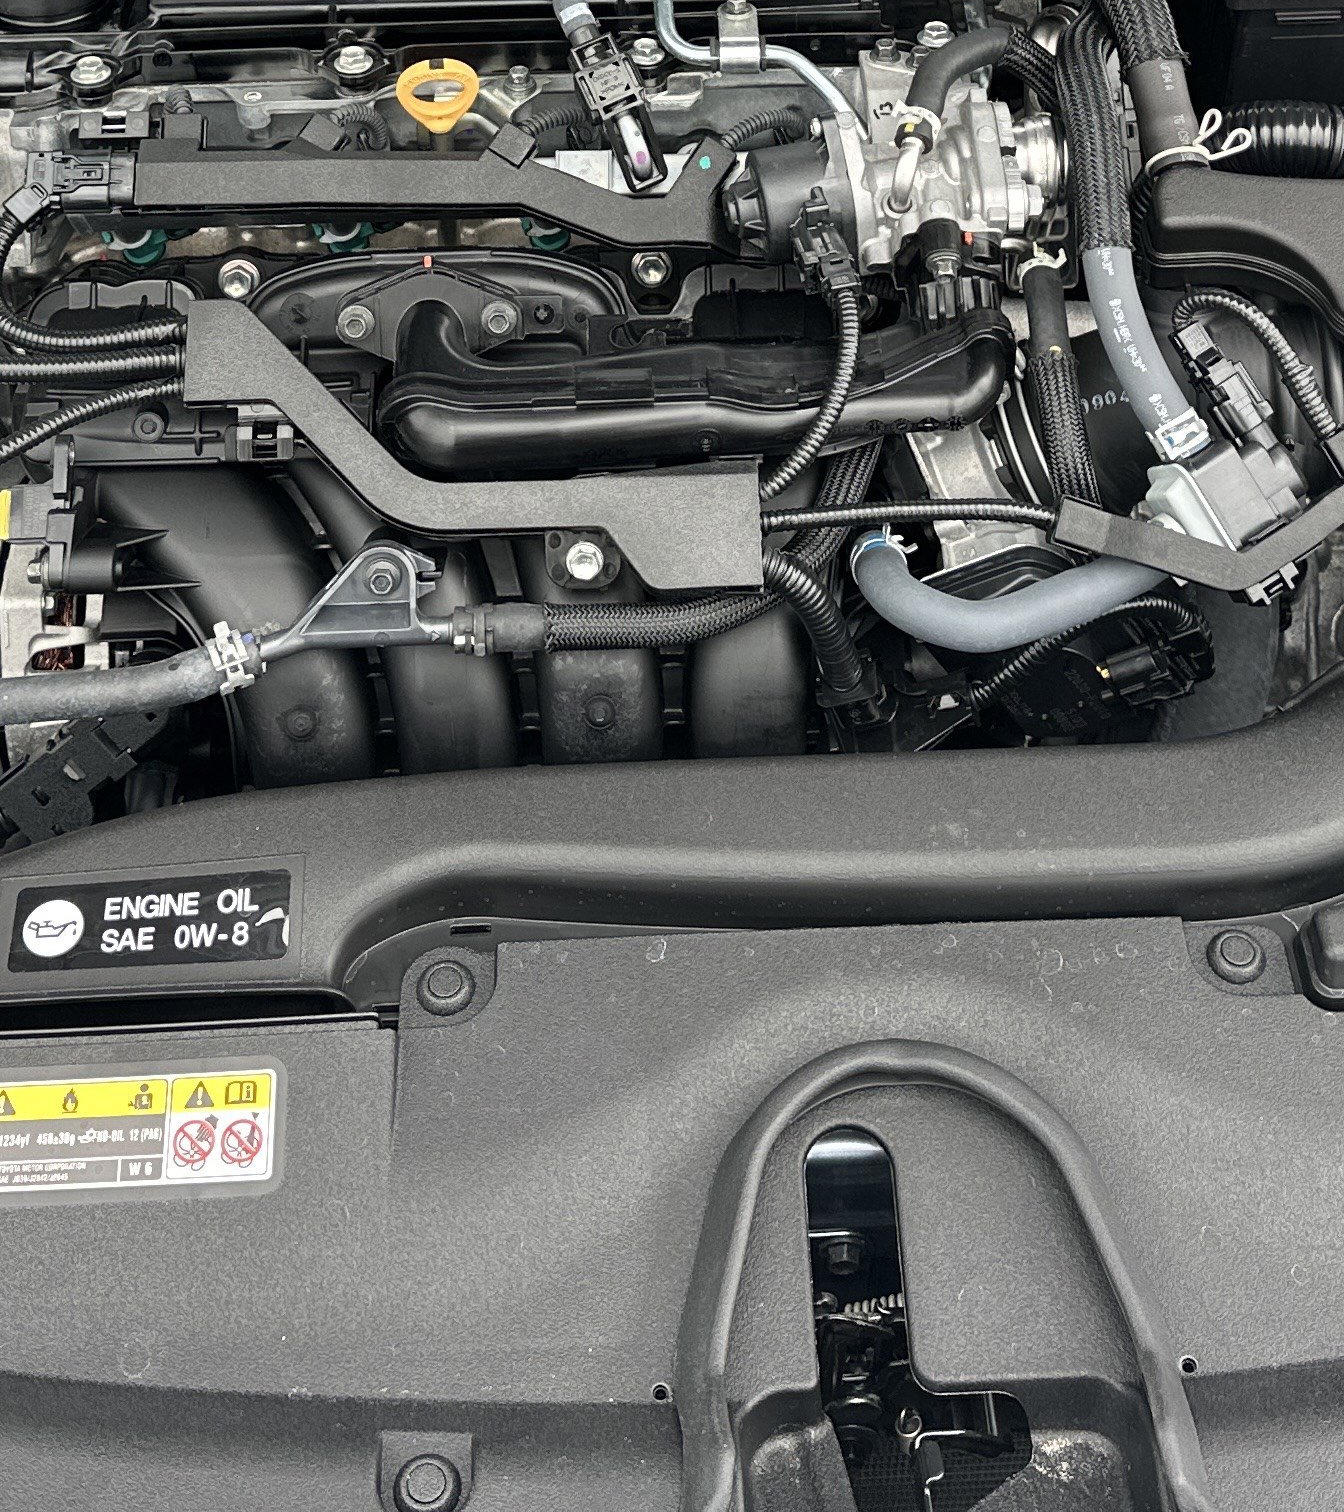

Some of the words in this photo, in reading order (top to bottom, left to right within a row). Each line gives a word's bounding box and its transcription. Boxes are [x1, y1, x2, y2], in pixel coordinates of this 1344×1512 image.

[104, 891, 200, 921] ENGINE
[216, 888, 259, 914] OIL
[100, 926, 156, 953] SAE
[174, 921, 249, 950] 0W-8
[129, 1162, 141, 1176] W
